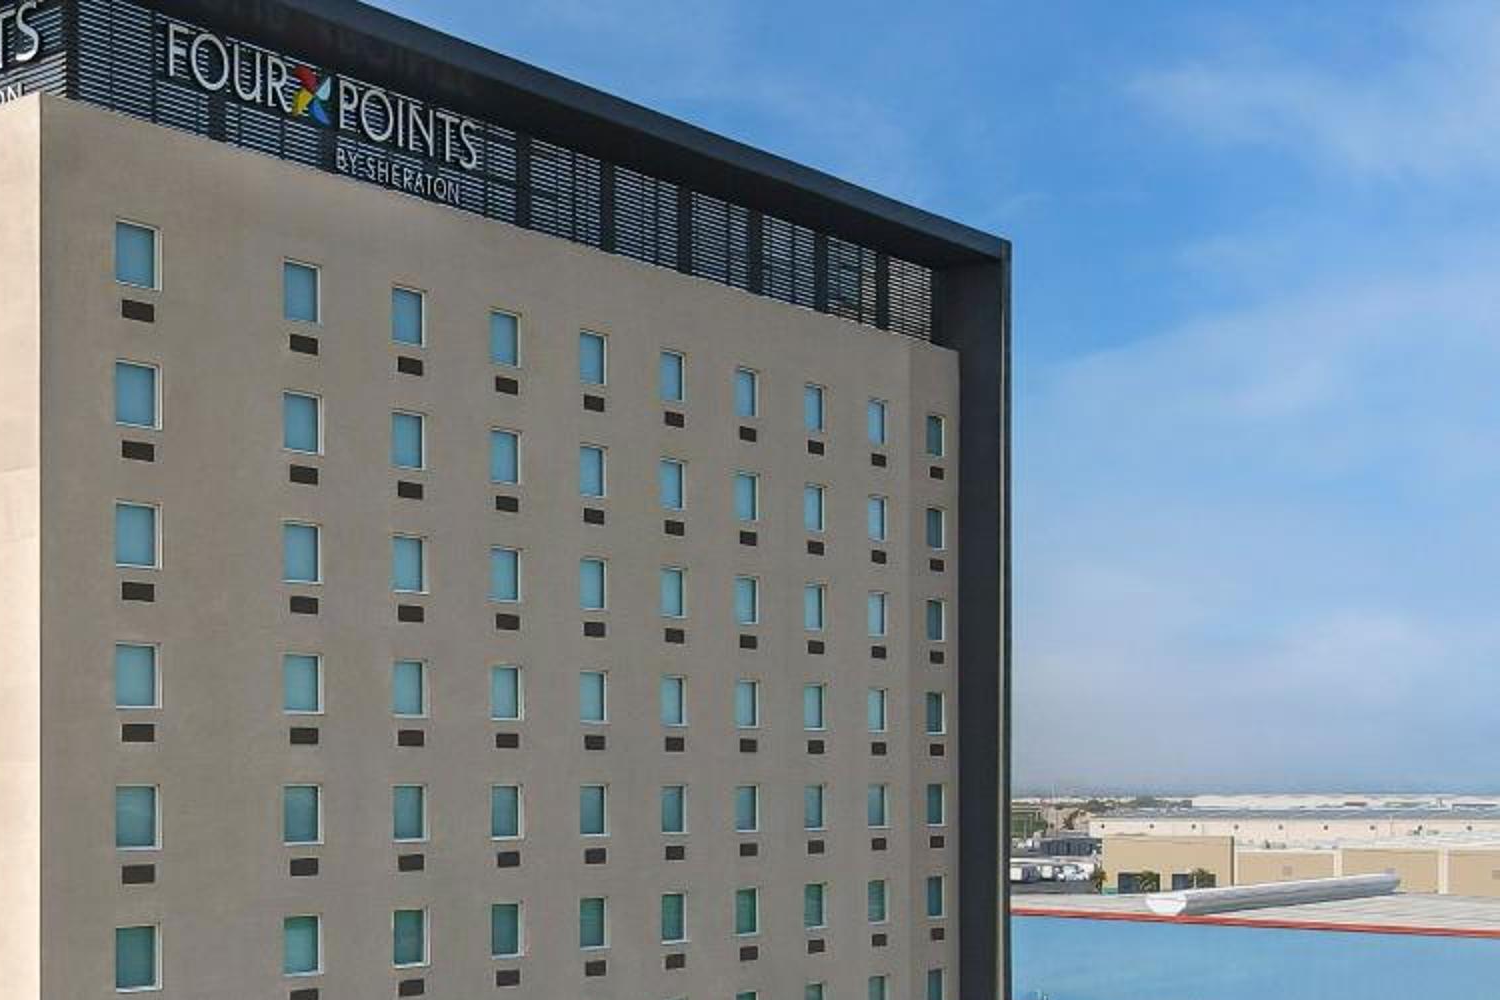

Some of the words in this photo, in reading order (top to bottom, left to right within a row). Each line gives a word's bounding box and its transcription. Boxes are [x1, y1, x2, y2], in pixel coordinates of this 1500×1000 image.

[167, 22, 293, 114] FOUR
[338, 79, 480, 170] POINTS
[336, 147, 358, 175] BY
[366, 157, 460, 204] SHERATON
